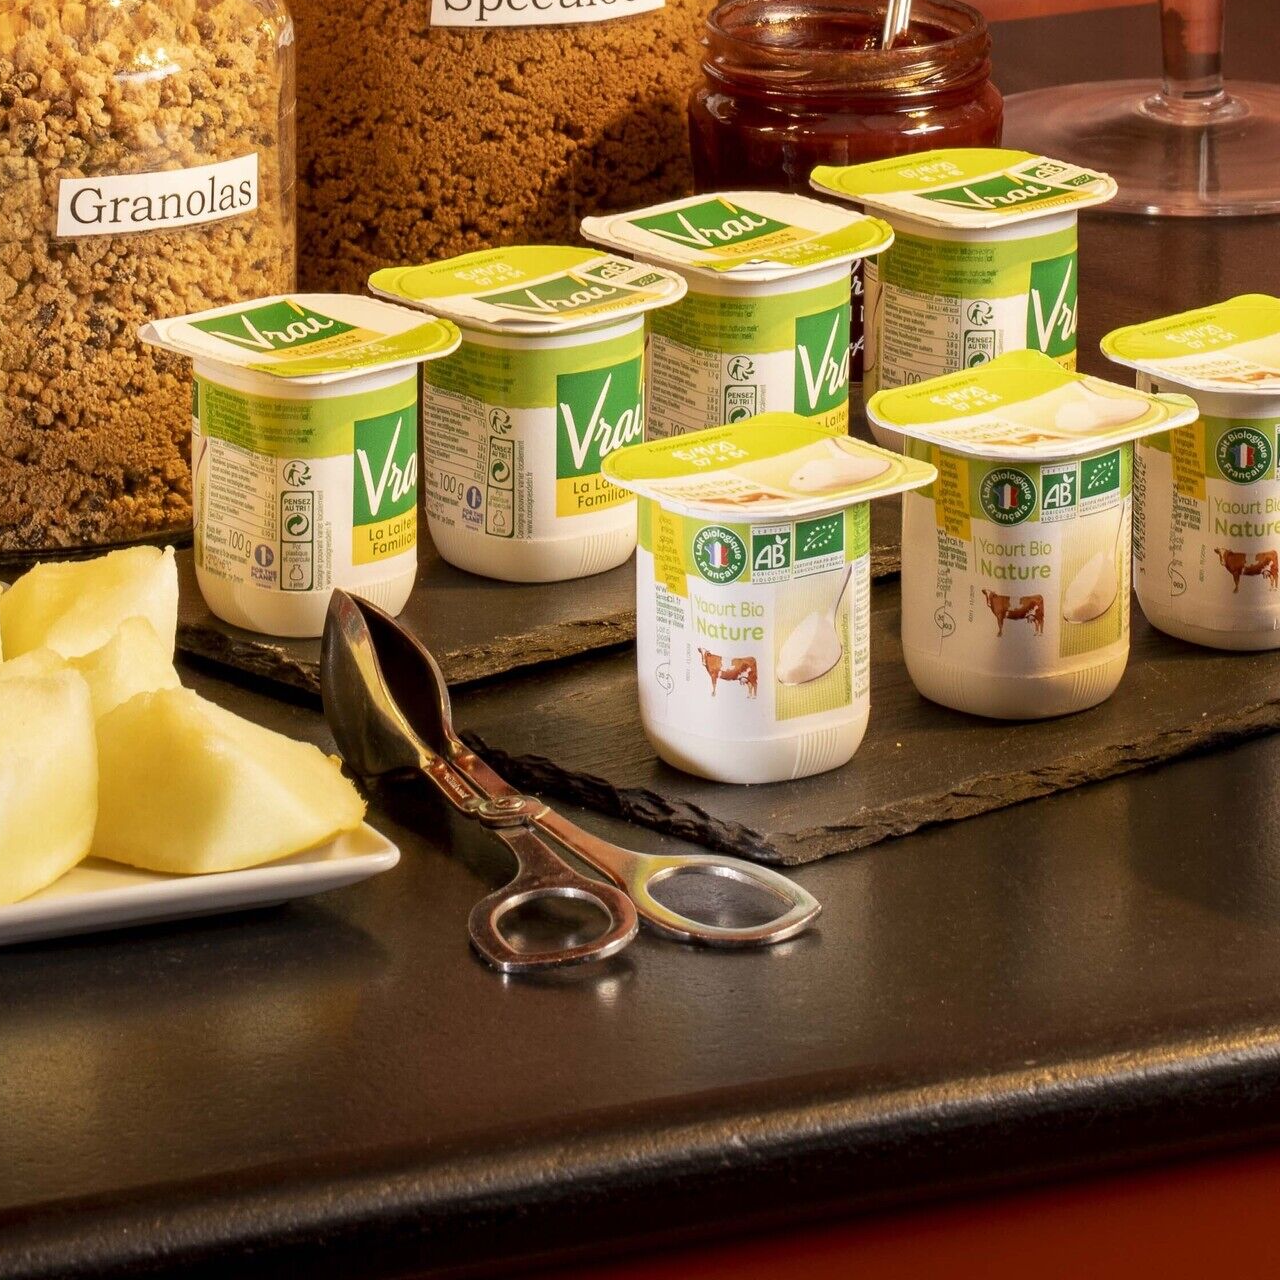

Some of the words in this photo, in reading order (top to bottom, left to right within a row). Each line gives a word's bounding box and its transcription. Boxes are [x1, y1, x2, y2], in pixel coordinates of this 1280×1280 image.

[69, 175, 253, 226] Granolas
[929, 171, 1051, 209] Vrai
[648, 199, 767, 247] Vrai
[494, 271, 617, 313] Vrai
[208, 299, 334, 350] Vrai
[967, 336, 992, 344] PENSEZ
[797, 313, 849, 410] Vra
[727, 392, 754, 400] PENSEZ
[1219, 439, 1229, 458] Lait
[1228, 431, 1268, 458] Biologique
[356, 416, 417, 517] Vra
[1224, 463, 1264, 480] Français
[440, 472, 456, 494] 100
[457, 483, 464, 501] g
[573, 481, 589, 495] La
[983, 478, 993, 499] Lait
[990, 472, 1032, 500] Biologique
[1044, 482, 1072, 509] AB
[283, 498, 311, 506] PENSEZ
[987, 502, 1028, 522] Français
[1214, 496, 1261, 515] Yaourt
[228, 529, 245, 551] 100
[245, 540, 252, 558] g
[369, 528, 384, 542] La
[695, 535, 705, 556] Lait
[702, 529, 742, 560] Biologique
[979, 537, 1025, 557] Yaourt
[1029, 540, 1052, 556] Bio
[755, 544, 785, 569] AB
[700, 560, 738, 581] Français
[981, 559, 1051, 581] Nature
[694, 596, 736, 617] Yaourt
[740, 601, 765, 618] Bio
[696, 618, 764, 641] Nature
